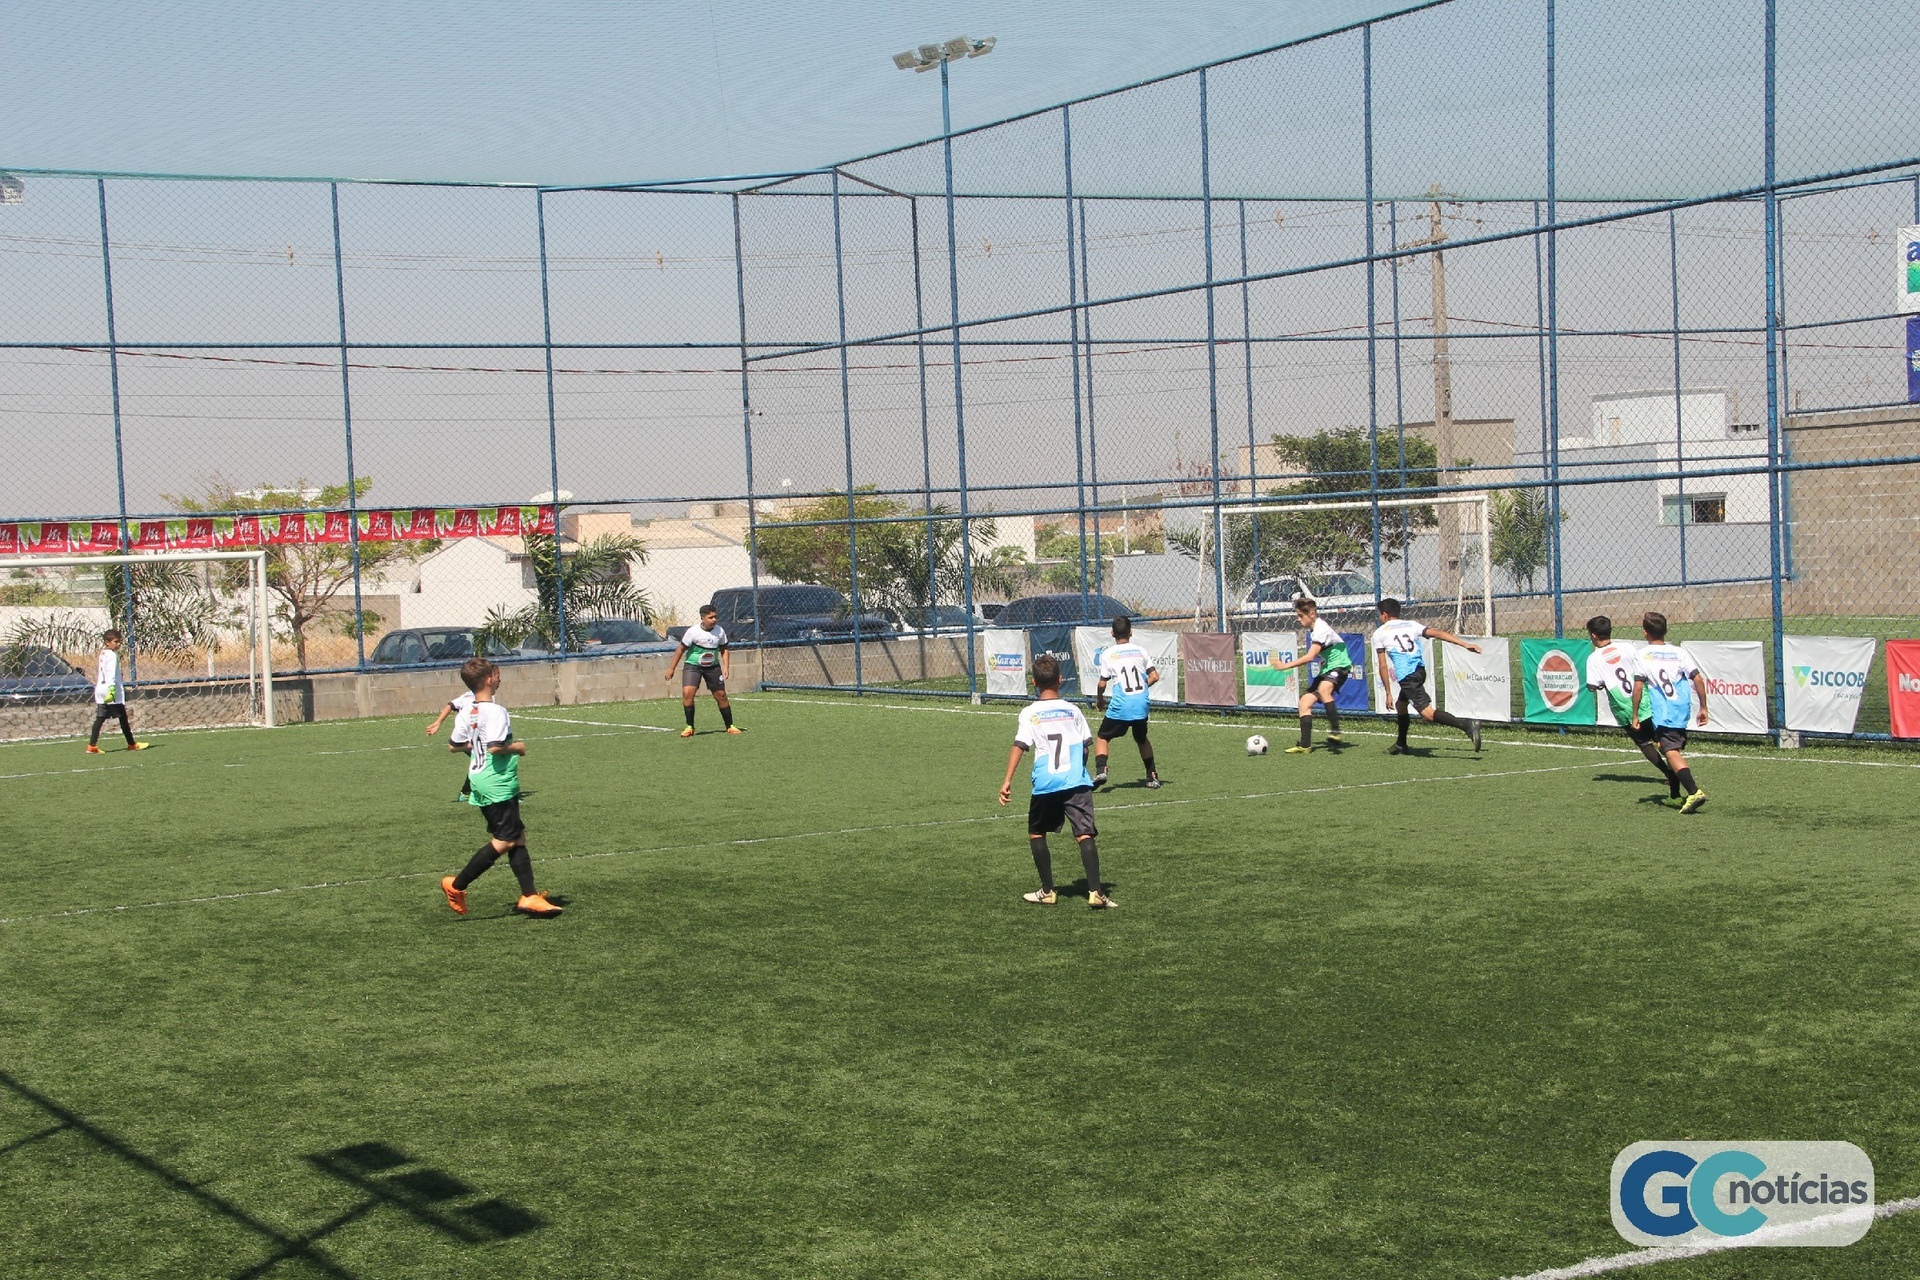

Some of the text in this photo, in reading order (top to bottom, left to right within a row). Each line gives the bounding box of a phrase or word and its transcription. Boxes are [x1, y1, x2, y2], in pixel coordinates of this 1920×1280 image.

[1394, 634, 1414, 653] 13
[1121, 665, 1143, 693] 11
[1615, 667, 1633, 694] 8
[1659, 669, 1674, 697] 8
[1705, 679, 1759, 695] Mônaco
[1810, 670, 1866, 688] SICOOB
[1047, 733, 1063, 770] 7
